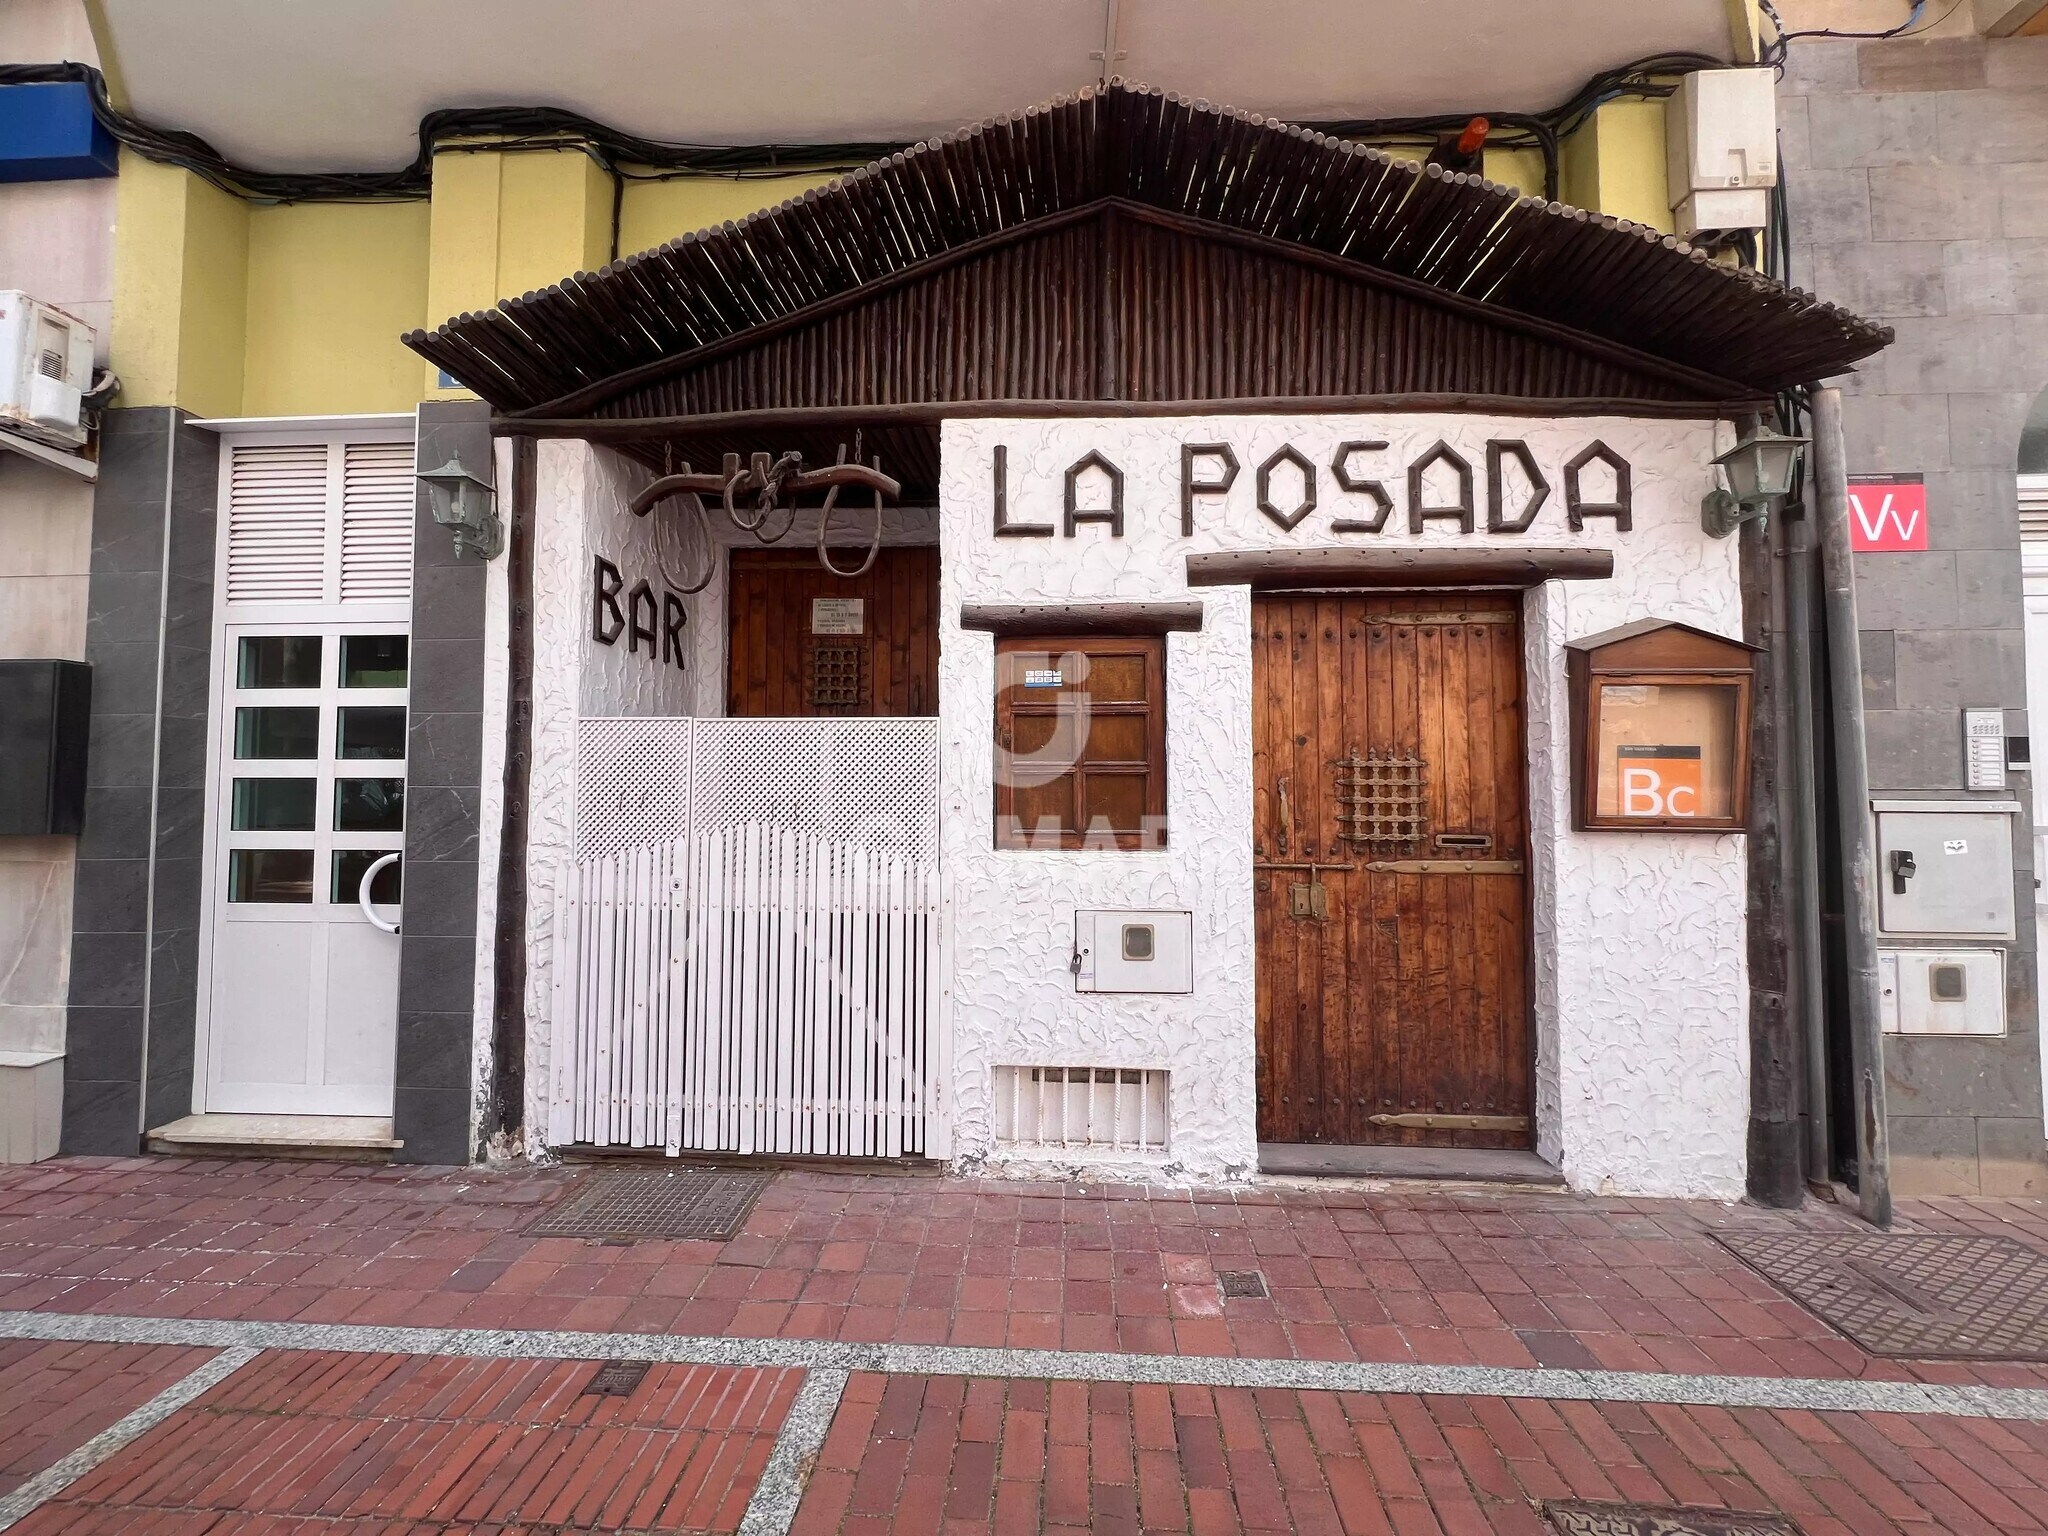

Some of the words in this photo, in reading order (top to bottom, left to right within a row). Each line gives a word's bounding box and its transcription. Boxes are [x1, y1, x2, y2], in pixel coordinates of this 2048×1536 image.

[993, 444, 1125, 538] LA
[1181, 438, 1633, 538] POSADA
[1848, 493, 1919, 542] Vv
[593, 553, 688, 671] BAR
[1623, 767, 1695, 817] Bc
